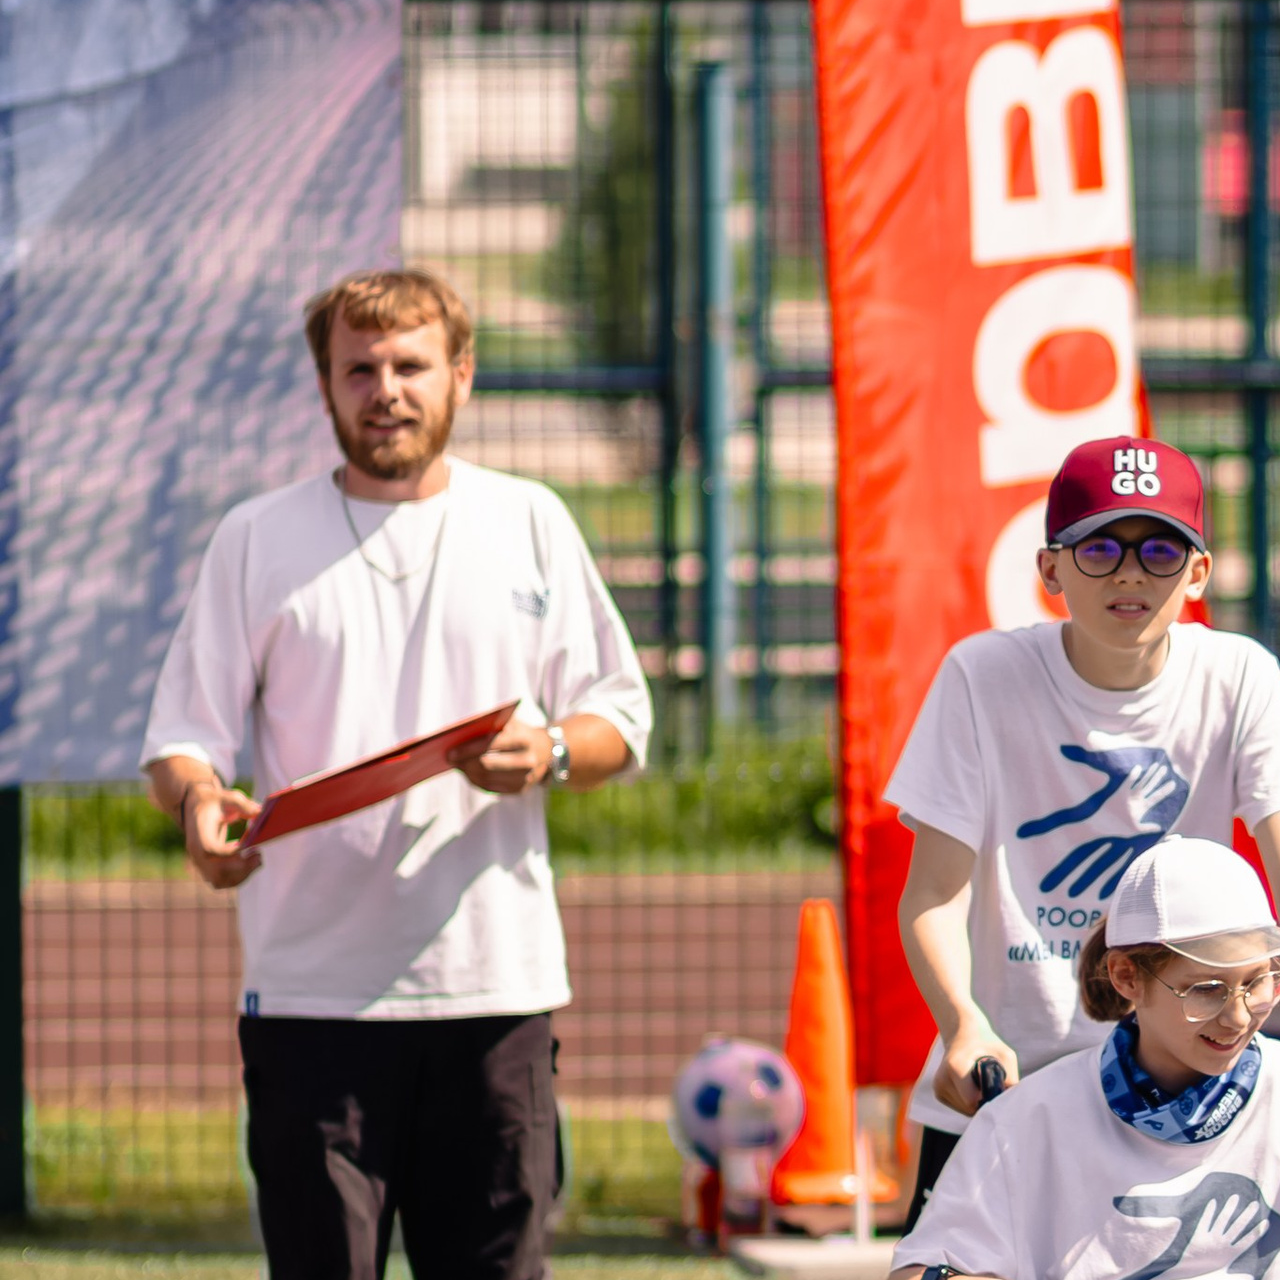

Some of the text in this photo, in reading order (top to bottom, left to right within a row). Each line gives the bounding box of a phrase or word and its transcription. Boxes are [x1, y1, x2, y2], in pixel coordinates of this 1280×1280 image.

[1113, 449, 1157, 472] HU
[1111, 471, 1161, 496] GO
[1037, 906, 1101, 928] РООР
[1194, 1088, 1238, 1140] ПЕРВЫХ
